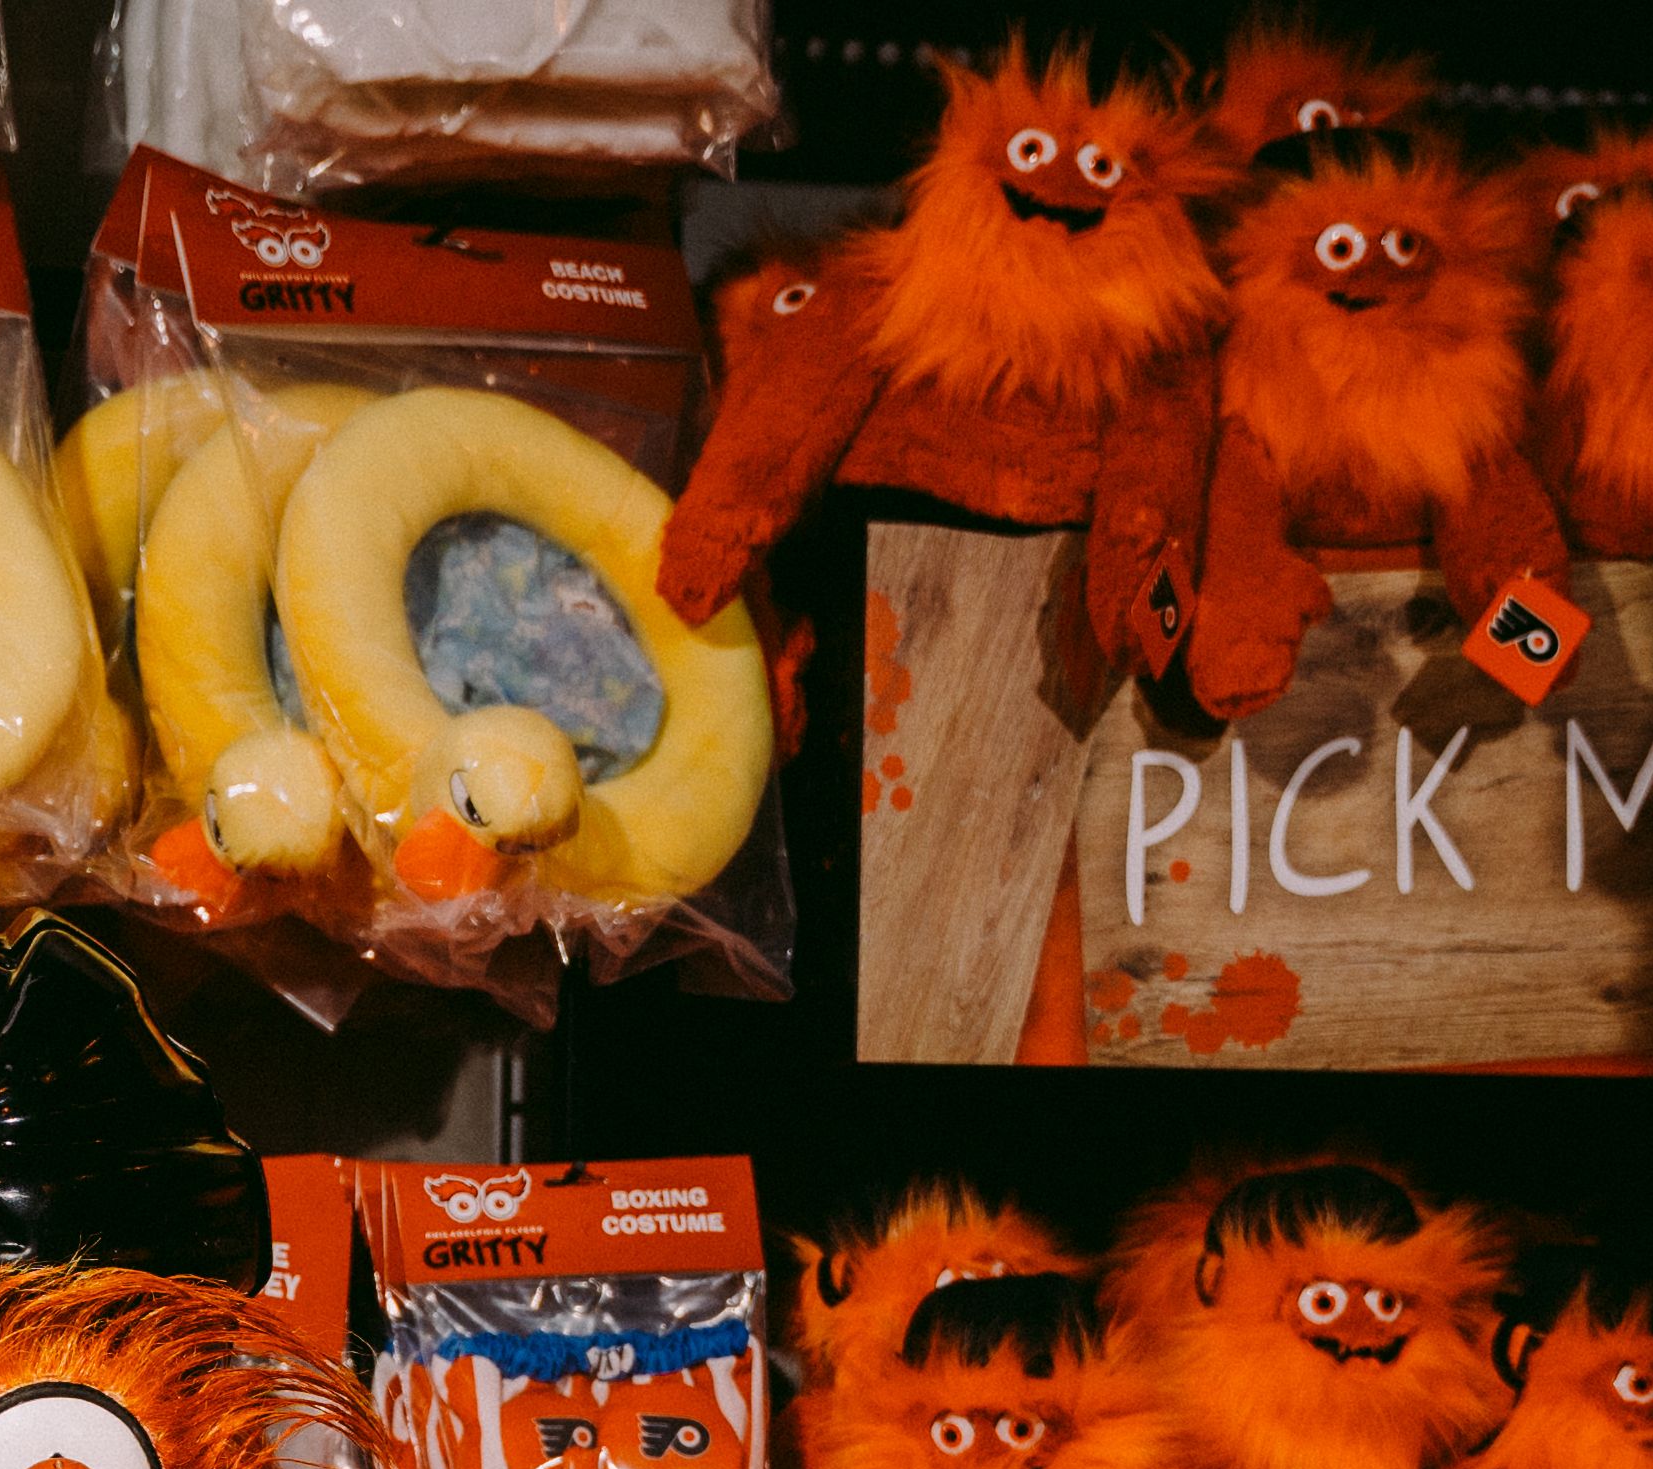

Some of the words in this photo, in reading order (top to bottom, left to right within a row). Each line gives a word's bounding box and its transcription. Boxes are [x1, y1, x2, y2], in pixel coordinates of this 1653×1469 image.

[548, 260, 625, 283] BEACH
[239, 281, 355, 312] GRITTY
[541, 280, 649, 309] COSTUME
[1125, 722, 1477, 927] PICK
[610, 1187, 709, 1210] BOXING
[601, 1212, 727, 1235] COSTUME
[422, 1236, 550, 1269] GRITTY
